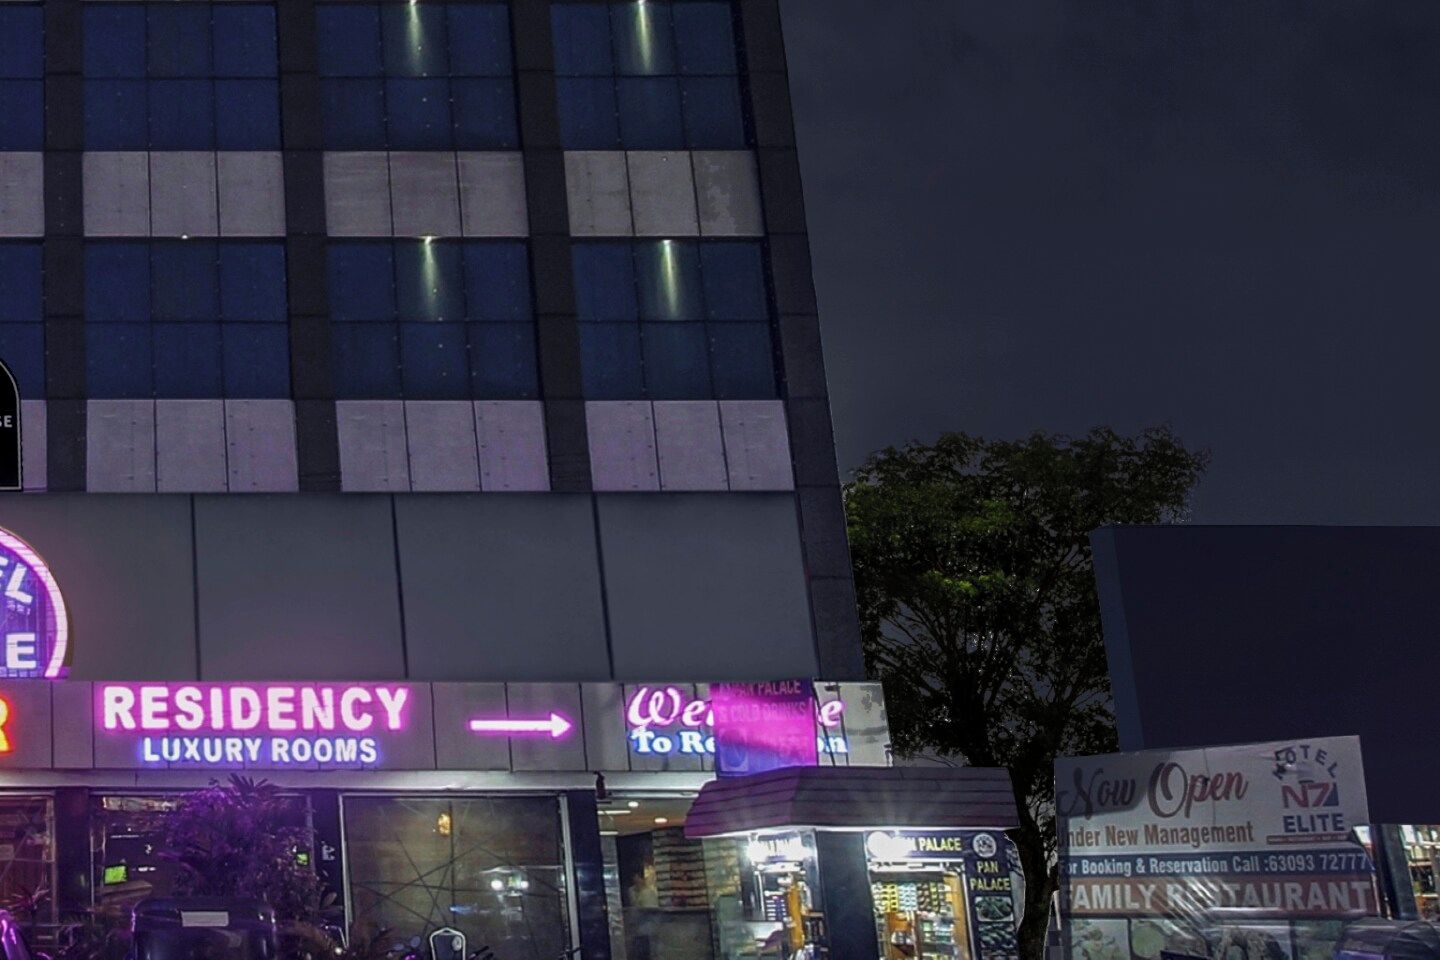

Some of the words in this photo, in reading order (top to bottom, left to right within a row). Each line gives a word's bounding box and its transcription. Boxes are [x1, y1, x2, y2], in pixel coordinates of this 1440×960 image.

[103, 686, 409, 730] RESIDENCY
[143, 737, 262, 762] LUXURY
[271, 737, 377, 763] ROOMS
[630, 728, 673, 753] To
[1056, 766, 1136, 820] Now
[1147, 762, 1249, 818] Open
[1069, 824, 1101, 847] nder
[1105, 825, 1138, 846] New
[1144, 820, 1254, 848] Management
[1282, 813, 1345, 833] ELITE
[918, 837, 963, 852] PALACE
[976, 860, 999, 874] PAN
[1082, 858, 1131, 877] Booking
[1135, 857, 1146, 874] &
[1150, 855, 1228, 874] Reservation
[1232, 855, 1260, 873] Call
[970, 878, 1011, 891] PALACE
